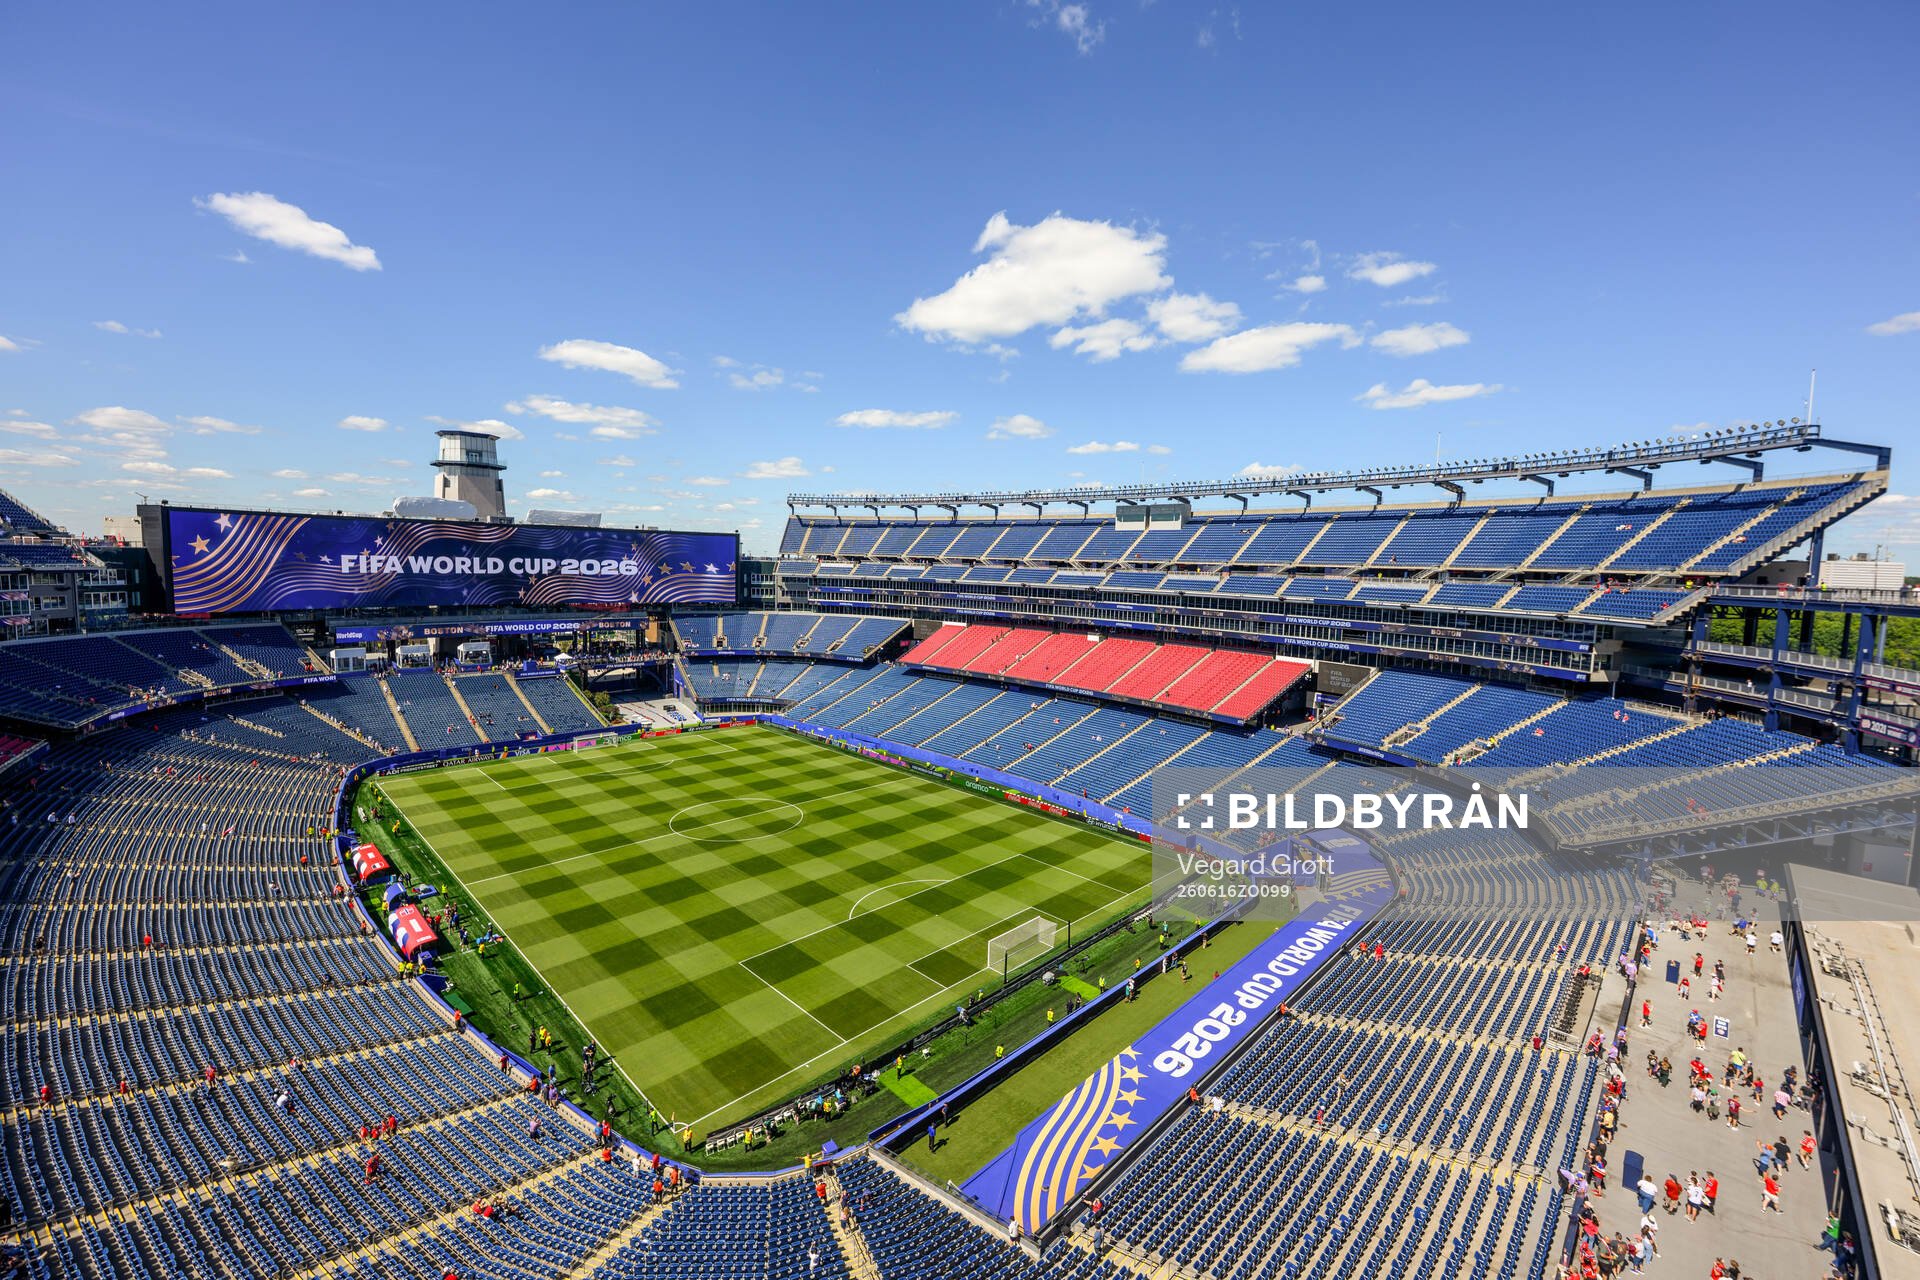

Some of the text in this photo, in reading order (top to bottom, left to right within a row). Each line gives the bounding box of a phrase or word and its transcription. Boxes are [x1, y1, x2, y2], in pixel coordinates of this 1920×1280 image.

[341, 555, 638, 575] FIFA WORLD CUP 2026
[424, 627, 463, 635] BOSTON
[1431, 629, 1461, 637] BOSTON
[1429, 654, 1459, 662] BOSTON
[204, 688, 232, 698] BOSTON
[443, 754, 494, 767] QATAR AIRWAYS
[966, 781, 988, 793] aramco
[1150, 837, 1174, 850] Lenovo
[1153, 904, 1364, 1078] FIFA WORLD CUP 2026
